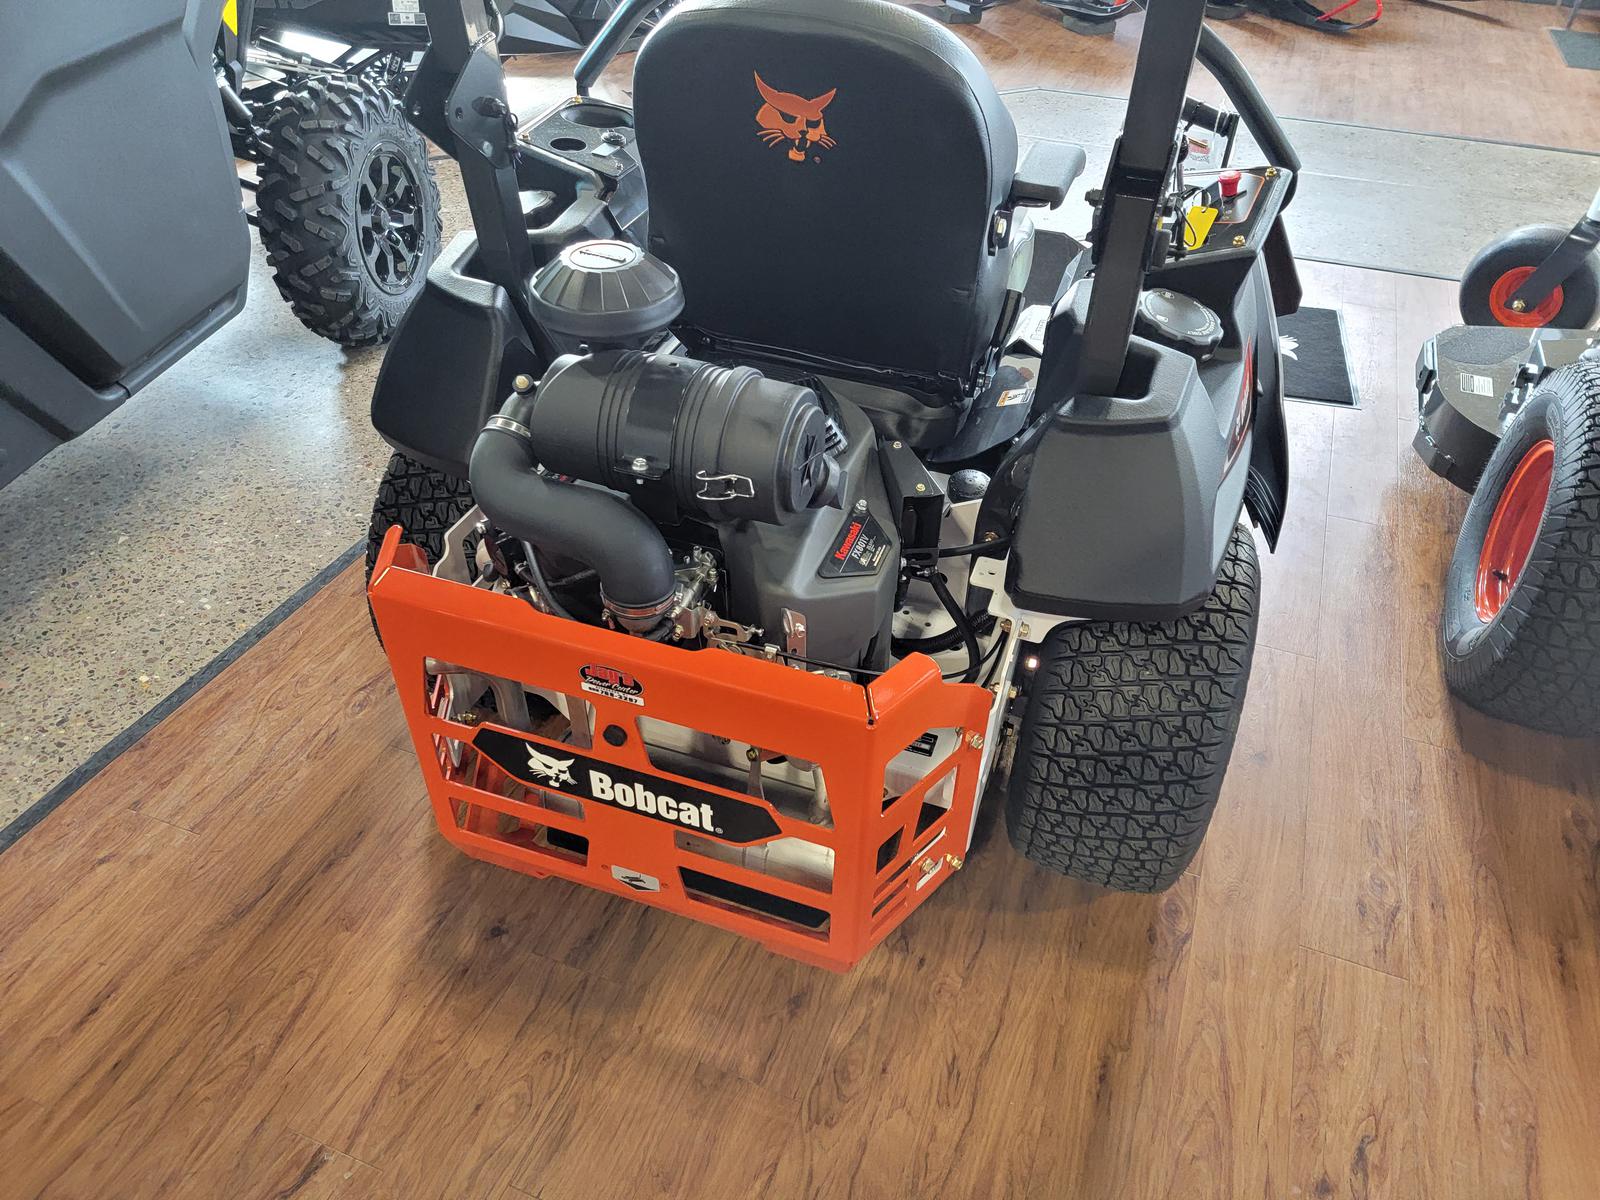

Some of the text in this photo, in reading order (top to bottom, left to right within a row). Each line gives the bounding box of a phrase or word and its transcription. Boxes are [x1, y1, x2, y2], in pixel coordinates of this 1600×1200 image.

[834, 522, 862, 561] Kawasaki
[851, 533, 869, 560] FX801V
[584, 663, 635, 687] Jay's
[585, 675, 611, 687] Power
[611, 683, 639, 696] Center
[588, 769, 714, 832] Bobcat
